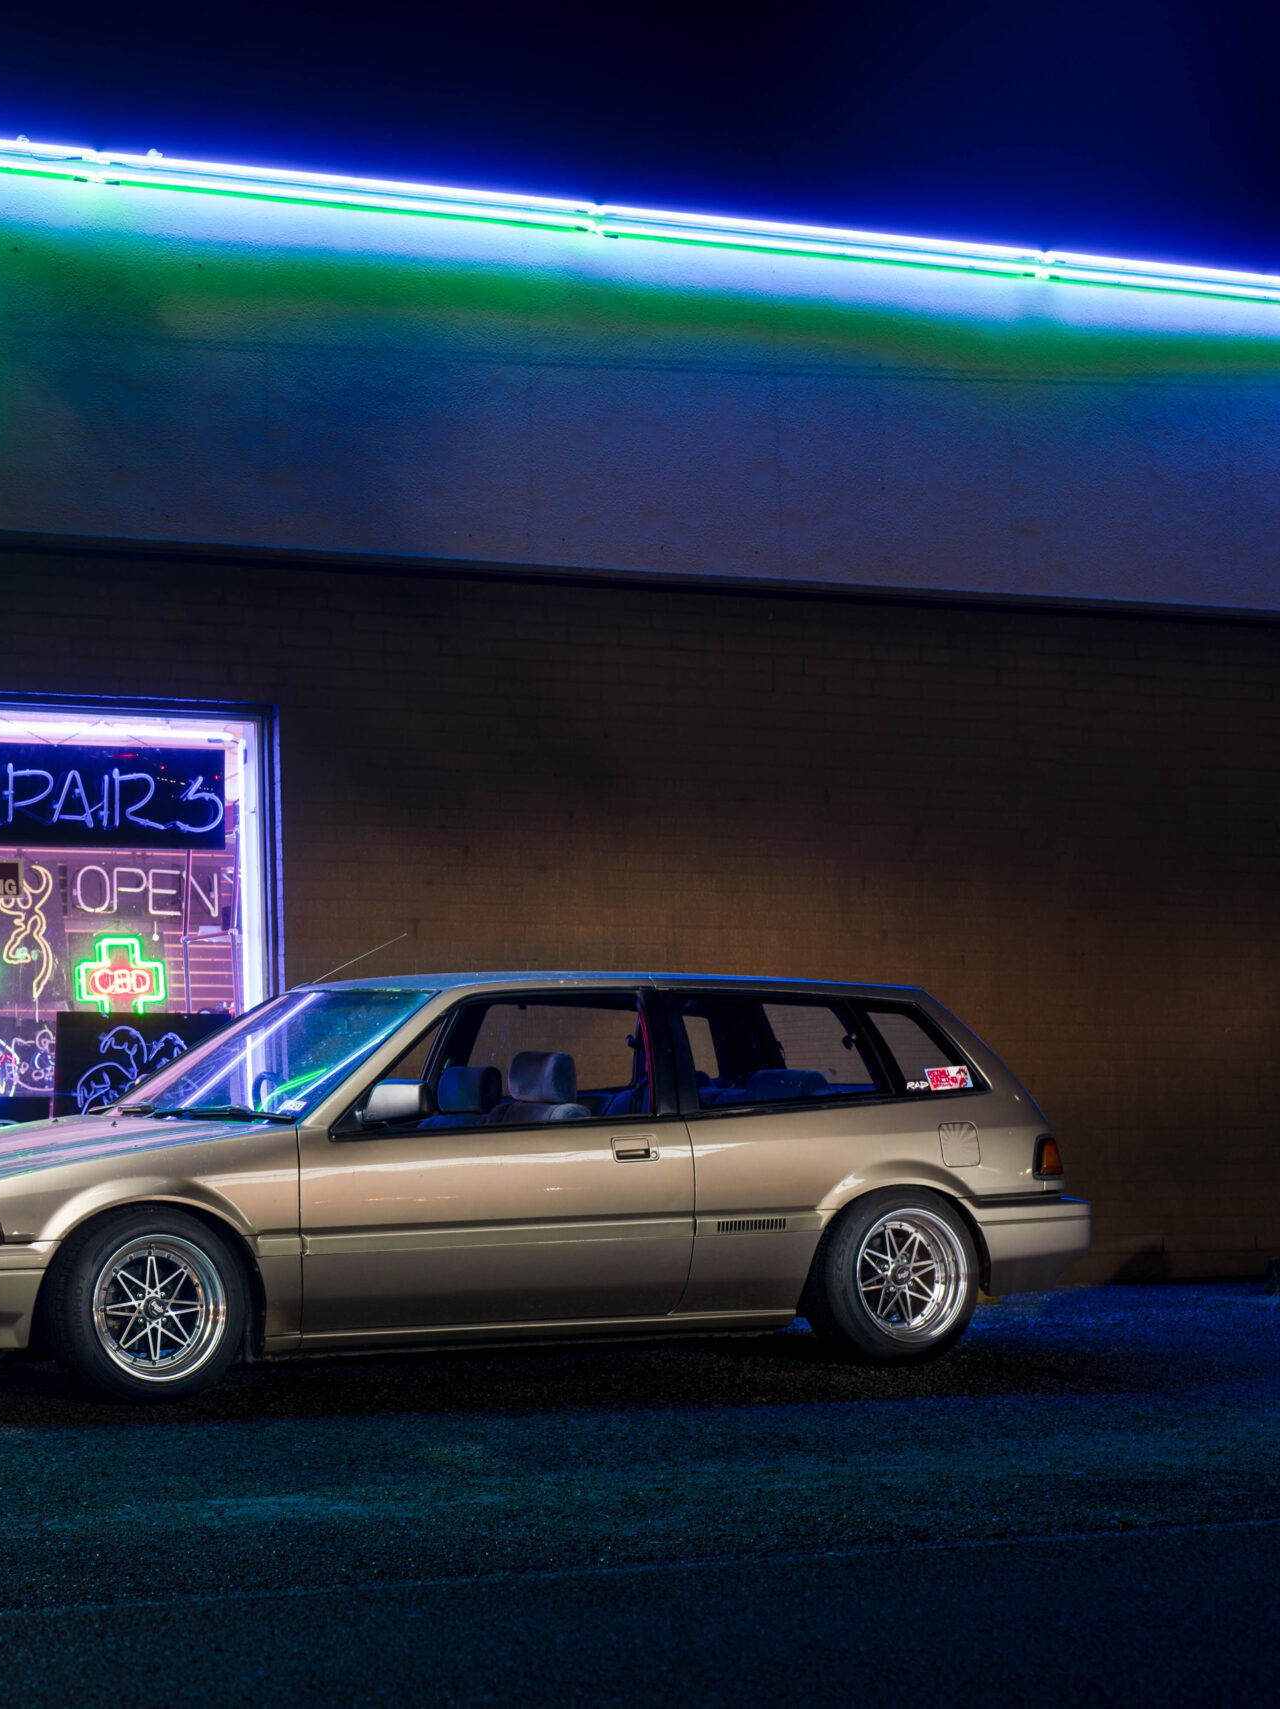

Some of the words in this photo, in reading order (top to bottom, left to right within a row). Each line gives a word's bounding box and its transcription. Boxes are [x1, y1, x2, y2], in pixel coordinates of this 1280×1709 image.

[75, 864, 219, 918] OPEN
[91, 966, 153, 995] CBD
[906, 1081, 929, 1091] RAD
